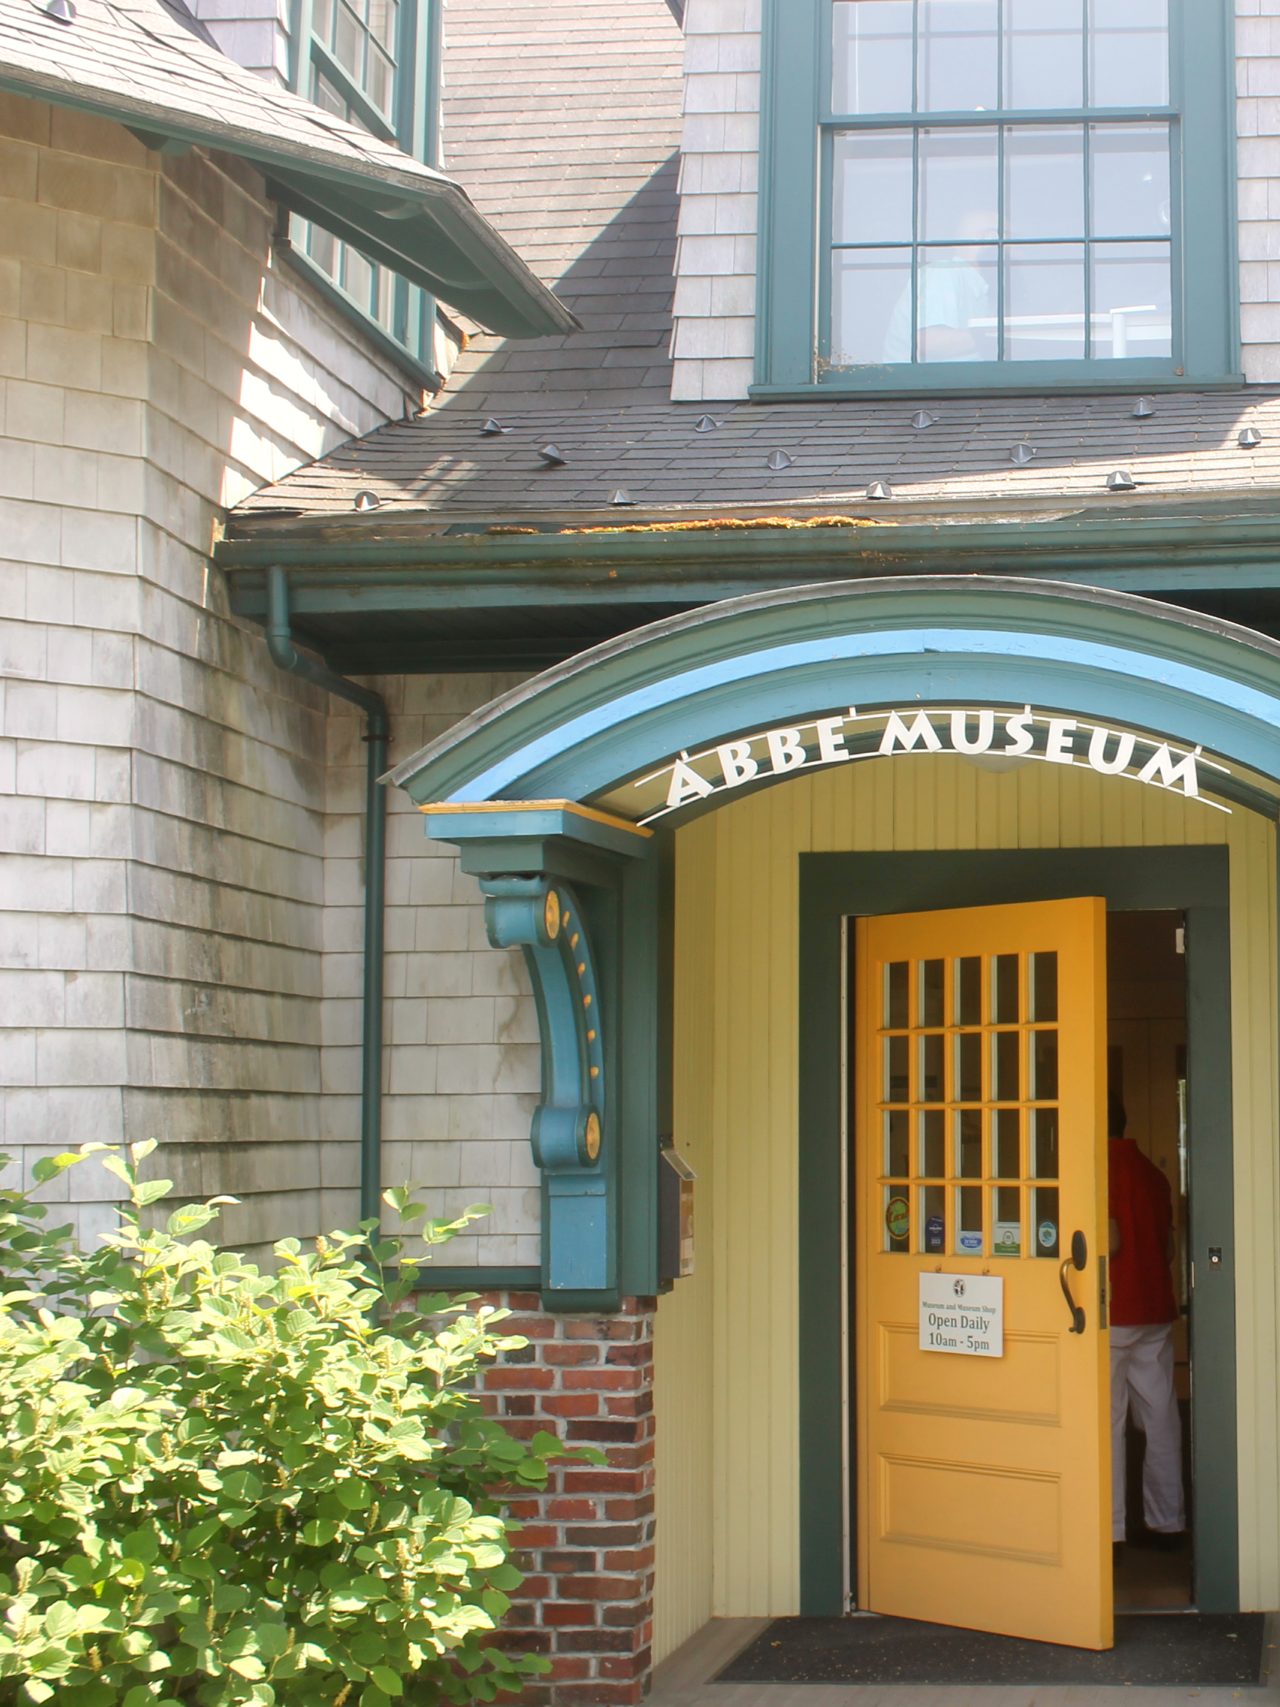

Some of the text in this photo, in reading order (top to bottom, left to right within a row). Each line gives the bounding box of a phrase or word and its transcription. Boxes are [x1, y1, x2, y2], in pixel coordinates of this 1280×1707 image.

[666, 709, 1200, 806] ABBE MUSEUM
[928, 1312, 990, 1334] Open Daily
[929, 1332, 957, 1347] 10am
[967, 1335, 990, 1352] 5pm
